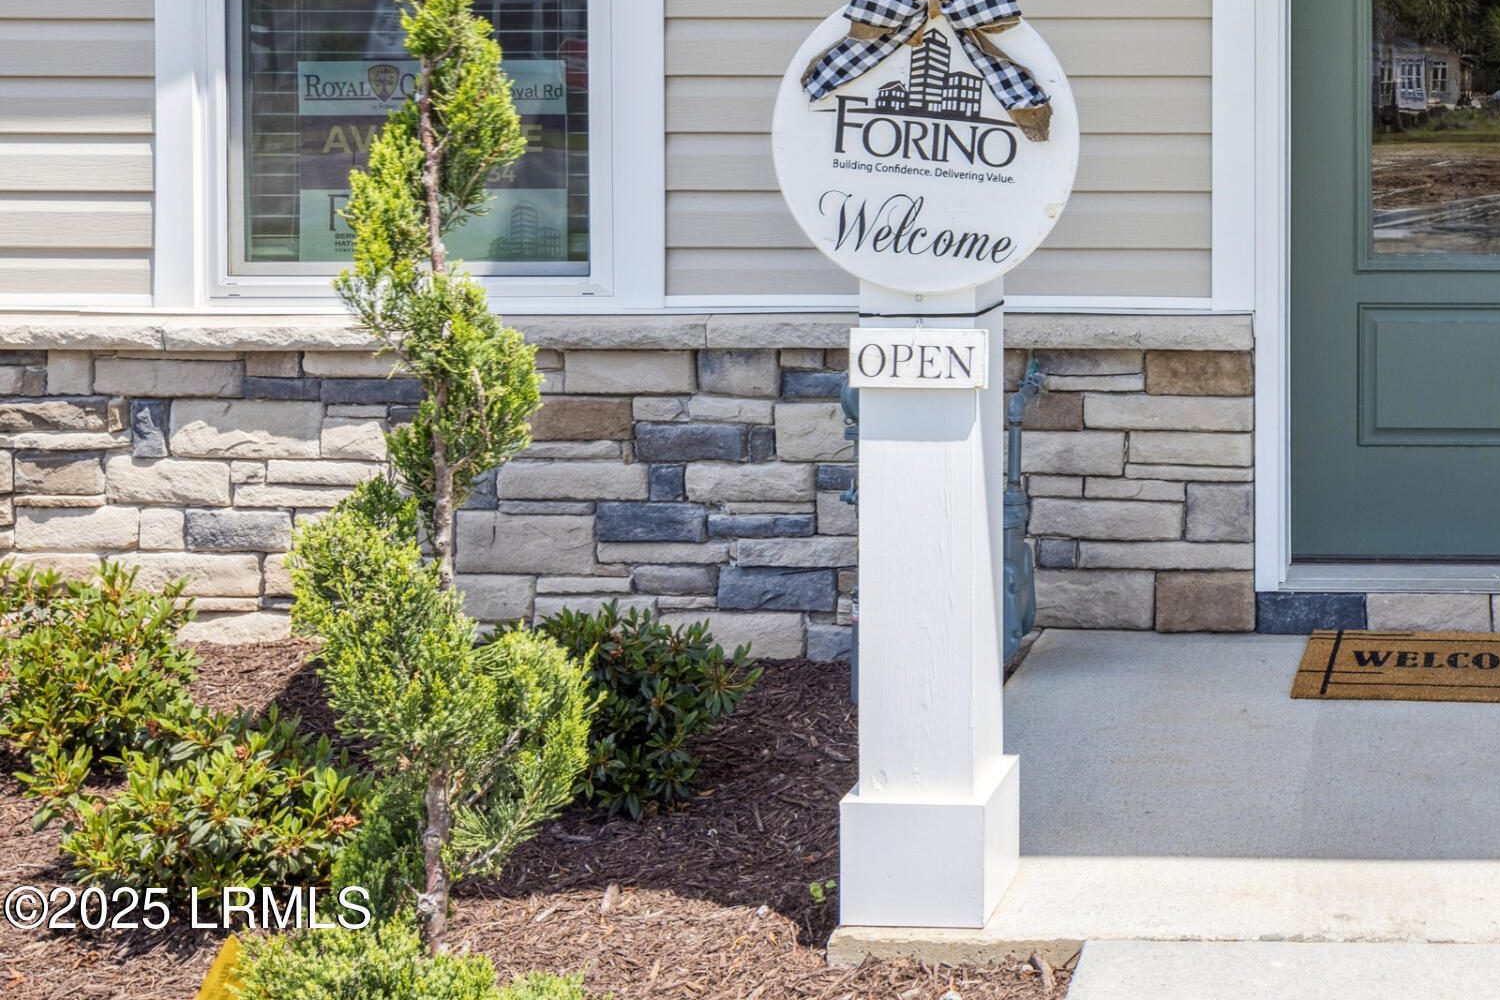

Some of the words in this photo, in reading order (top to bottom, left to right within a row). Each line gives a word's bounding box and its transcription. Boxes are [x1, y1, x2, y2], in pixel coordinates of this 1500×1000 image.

[303, 74, 371, 98] ROYAL
[502, 84, 538, 100] oyal
[543, 84, 563, 98] Rd
[834, 95, 1018, 168] FORINO
[832, 158, 873, 173] Building
[874, 162, 933, 177] Confidence.
[934, 167, 985, 182] Delivering
[986, 172, 1016, 184] Value.
[818, 190, 1017, 264] Welcome
[857, 343, 976, 379] OPEN
